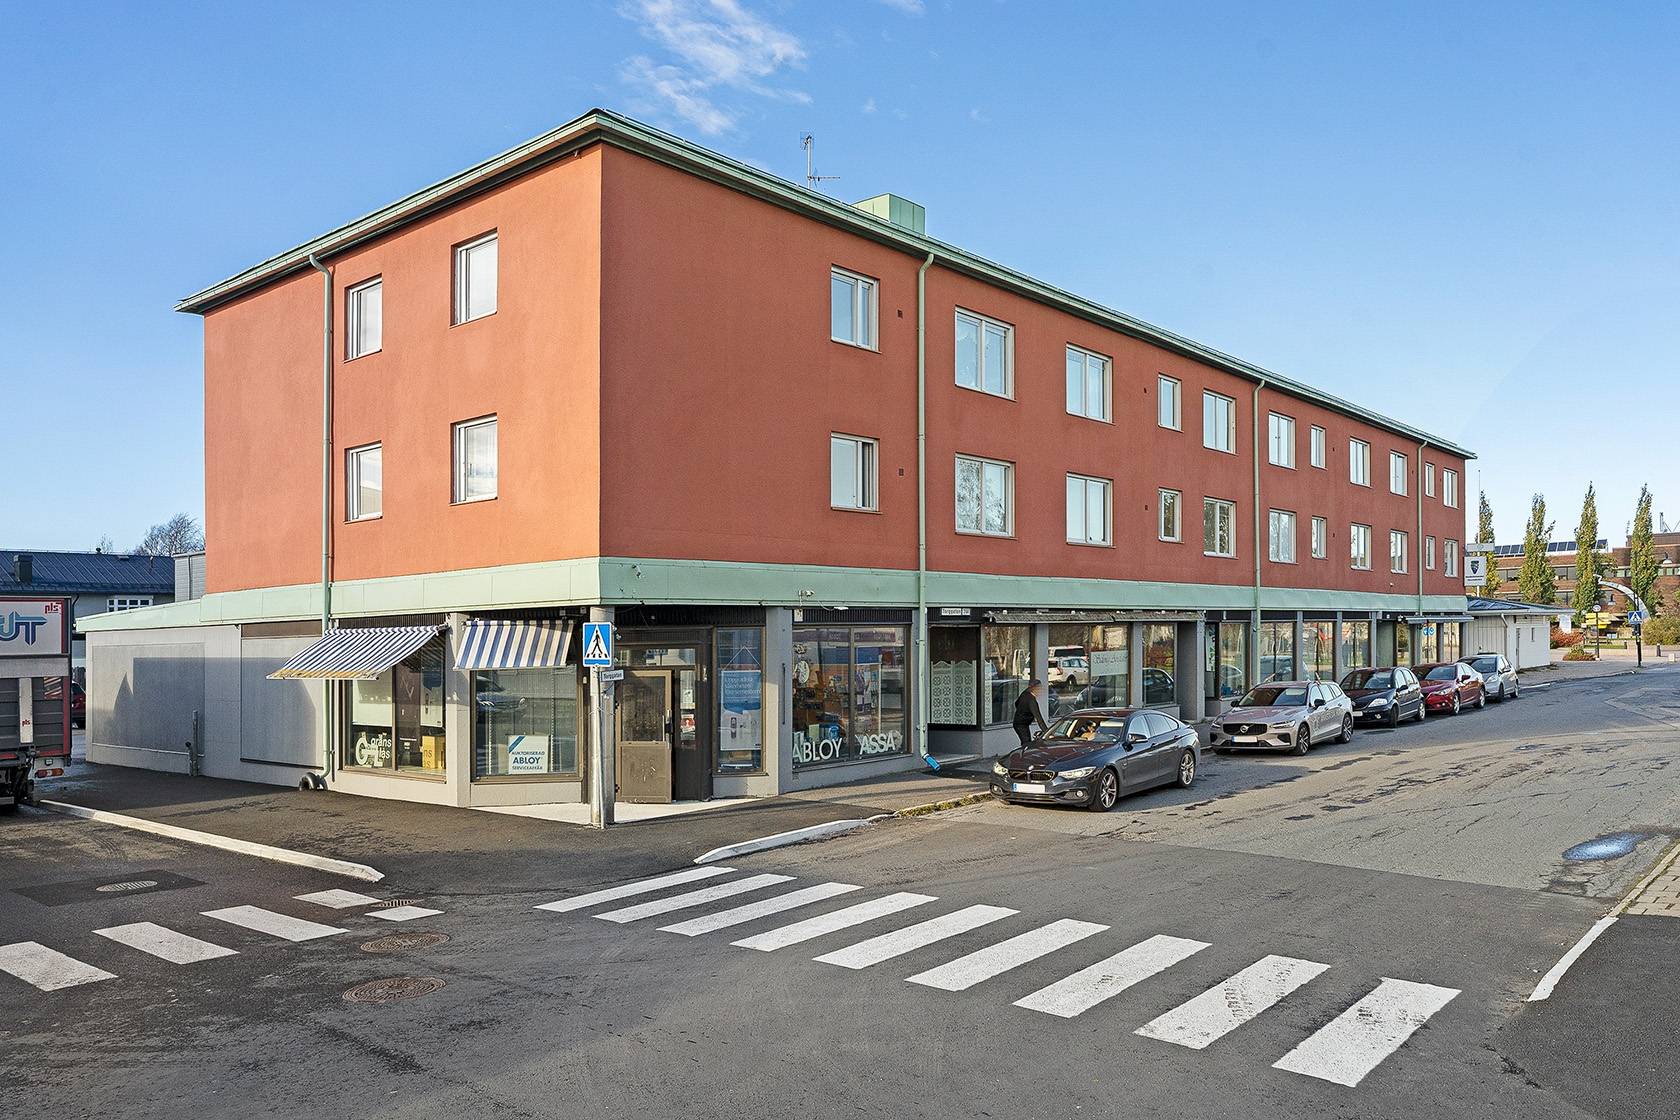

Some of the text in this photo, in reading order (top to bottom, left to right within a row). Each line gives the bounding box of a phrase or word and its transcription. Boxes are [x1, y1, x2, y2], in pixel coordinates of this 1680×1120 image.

[44, 602, 59, 614] pls
[792, 738, 842, 762] ABLOY
[512, 756, 541, 765] ABLOY
